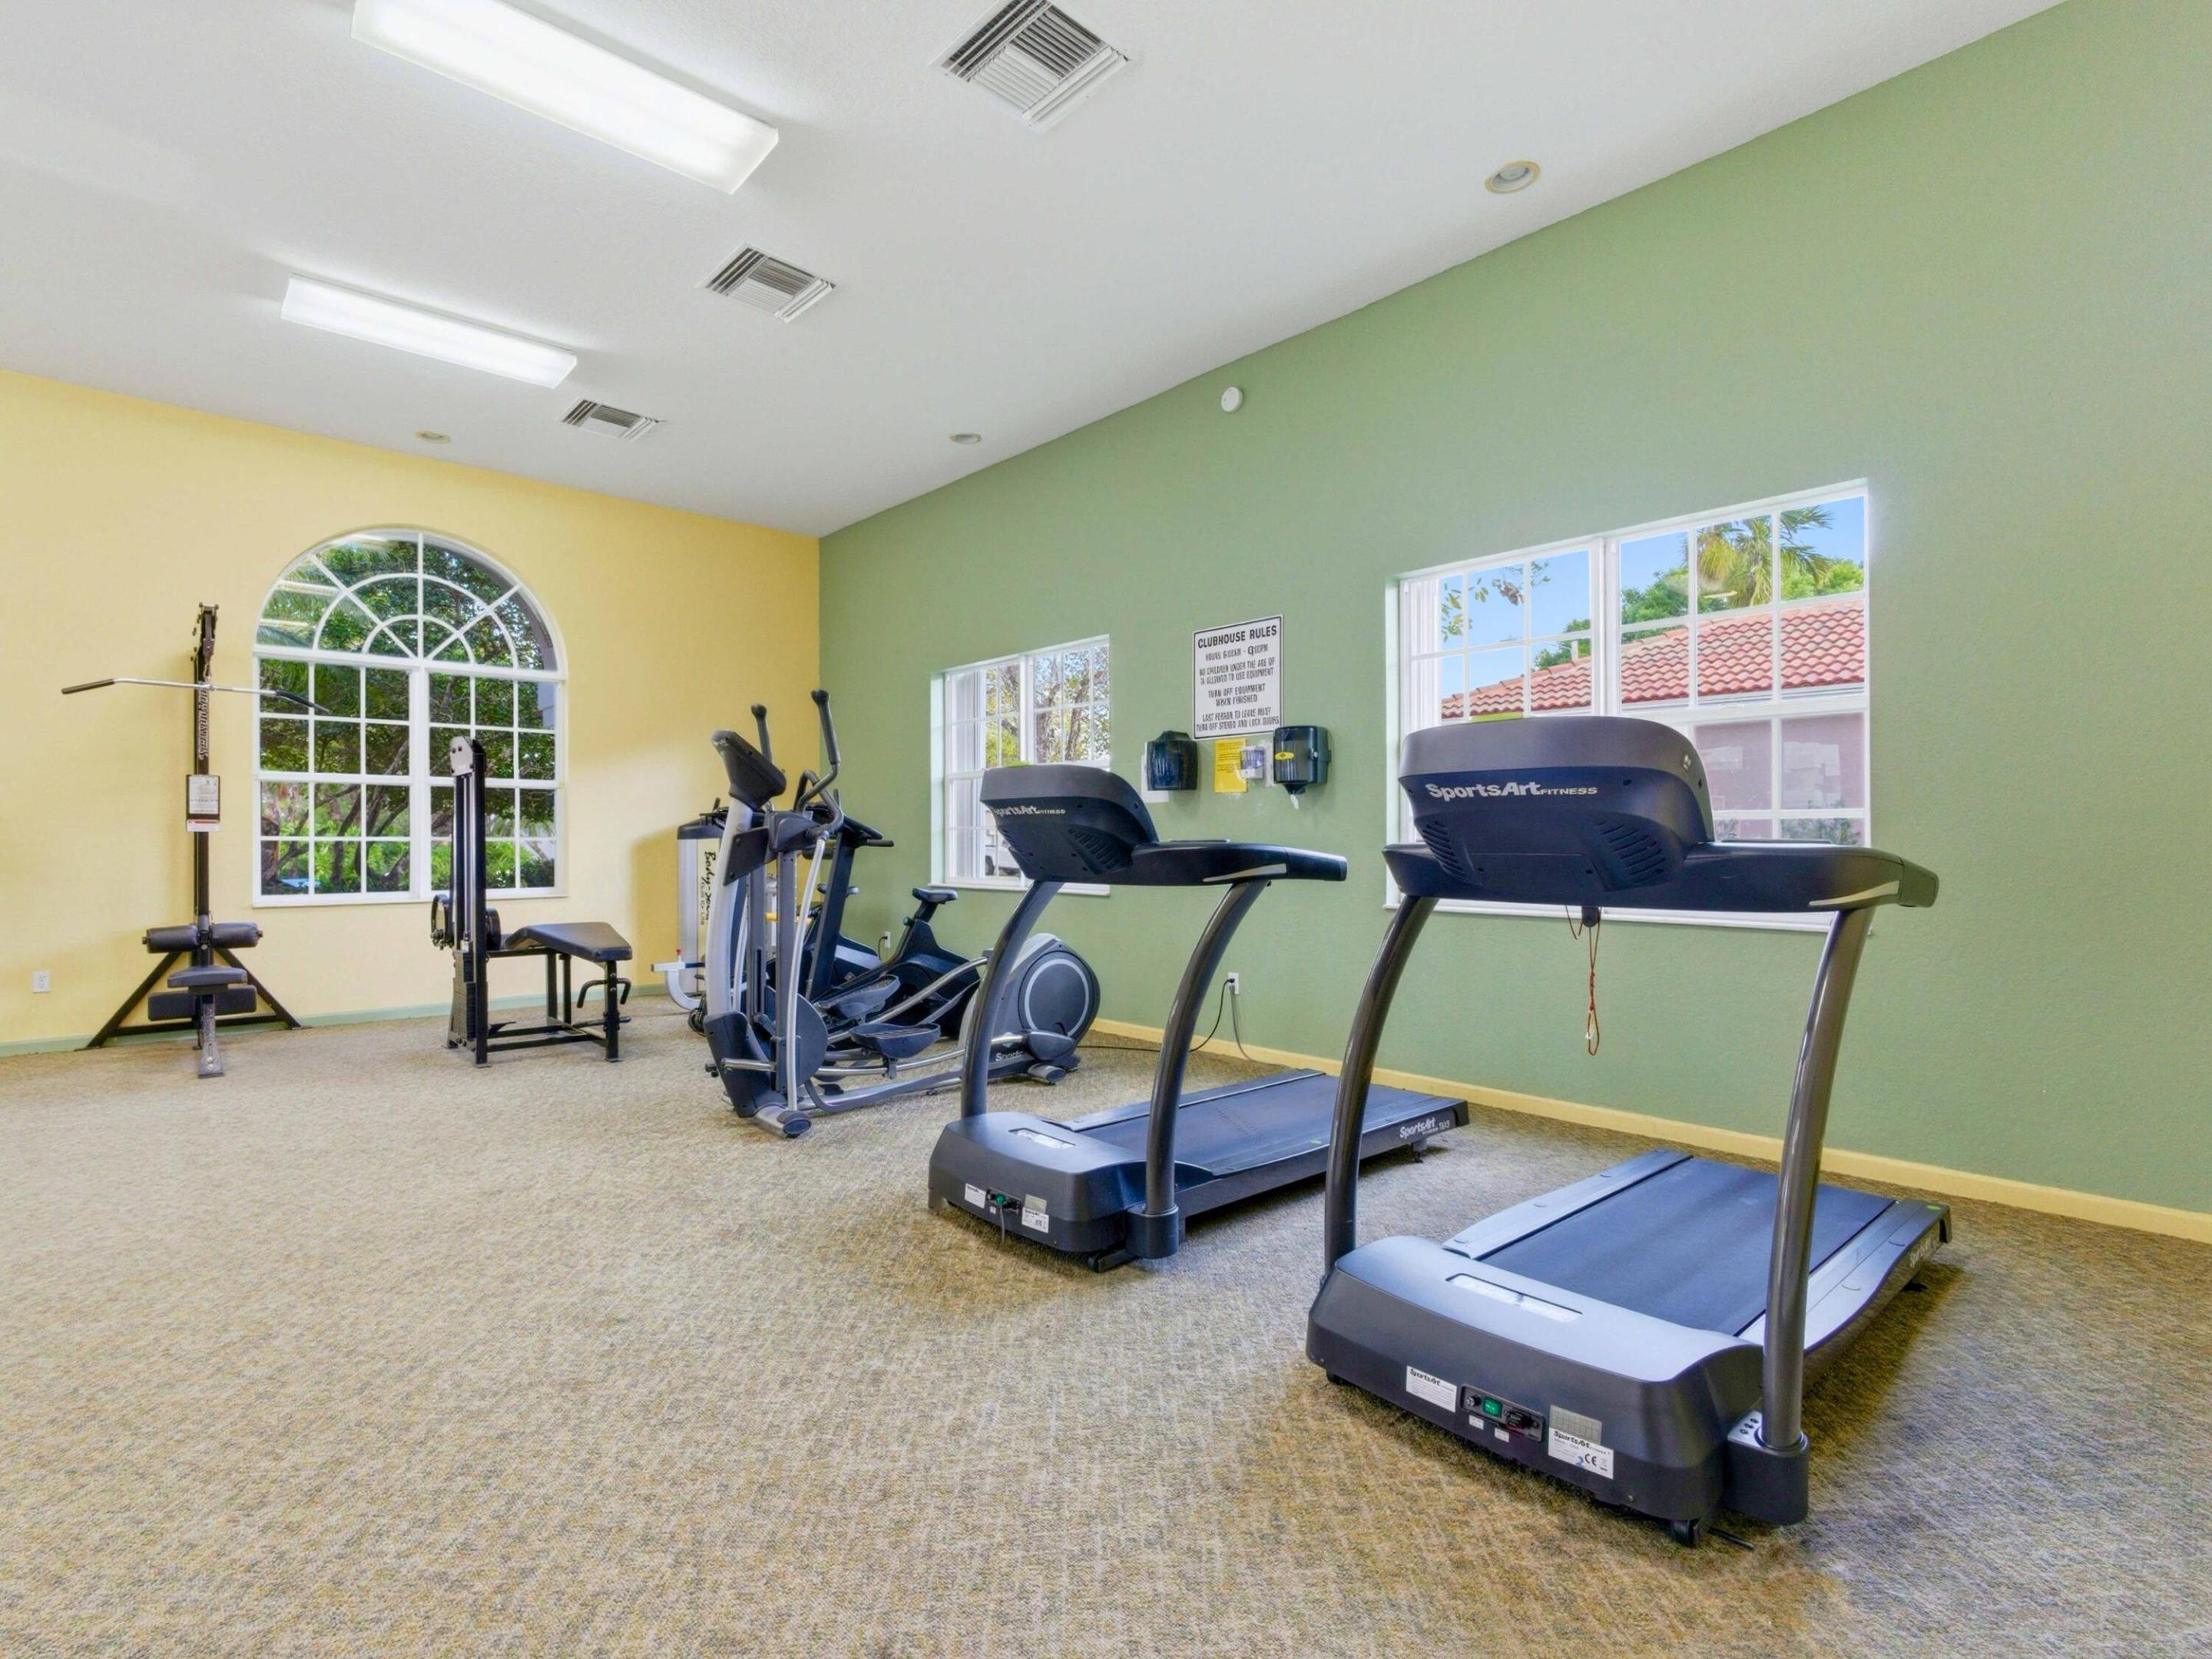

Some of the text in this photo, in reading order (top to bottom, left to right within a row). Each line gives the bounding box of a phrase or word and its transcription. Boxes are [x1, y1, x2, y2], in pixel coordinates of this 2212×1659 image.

[1197, 624, 1277, 649] CLUBHOUSE RULES
[1199, 657, 1274, 676] NO CHILDREN UNDER THE AGE OF
[1206, 674, 1227, 685] ALLOWED
[1236, 671, 1244, 680] USE
[1247, 667, 1273, 679] EQUIPMENT
[1208, 682, 1265, 698] TURN OFF EQUIPMENT
[1216, 694, 1257, 707] WHEN FINISHED
[1202, 706, 1270, 721] LAST PERSON TO LEAVE MUST
[1197, 724, 1207, 732] TURN
[1219, 720, 1236, 730] STEREO
[1237, 719, 1247, 728] AND
[1249, 717, 1260, 727] LOCK
[1263, 715, 1279, 726] DOORS
[1425, 782, 1598, 801] SportsArt FITNESS
[1399, 1117, 1435, 1139] SportsArt
[1555, 1430, 1591, 1449] SportsArt
